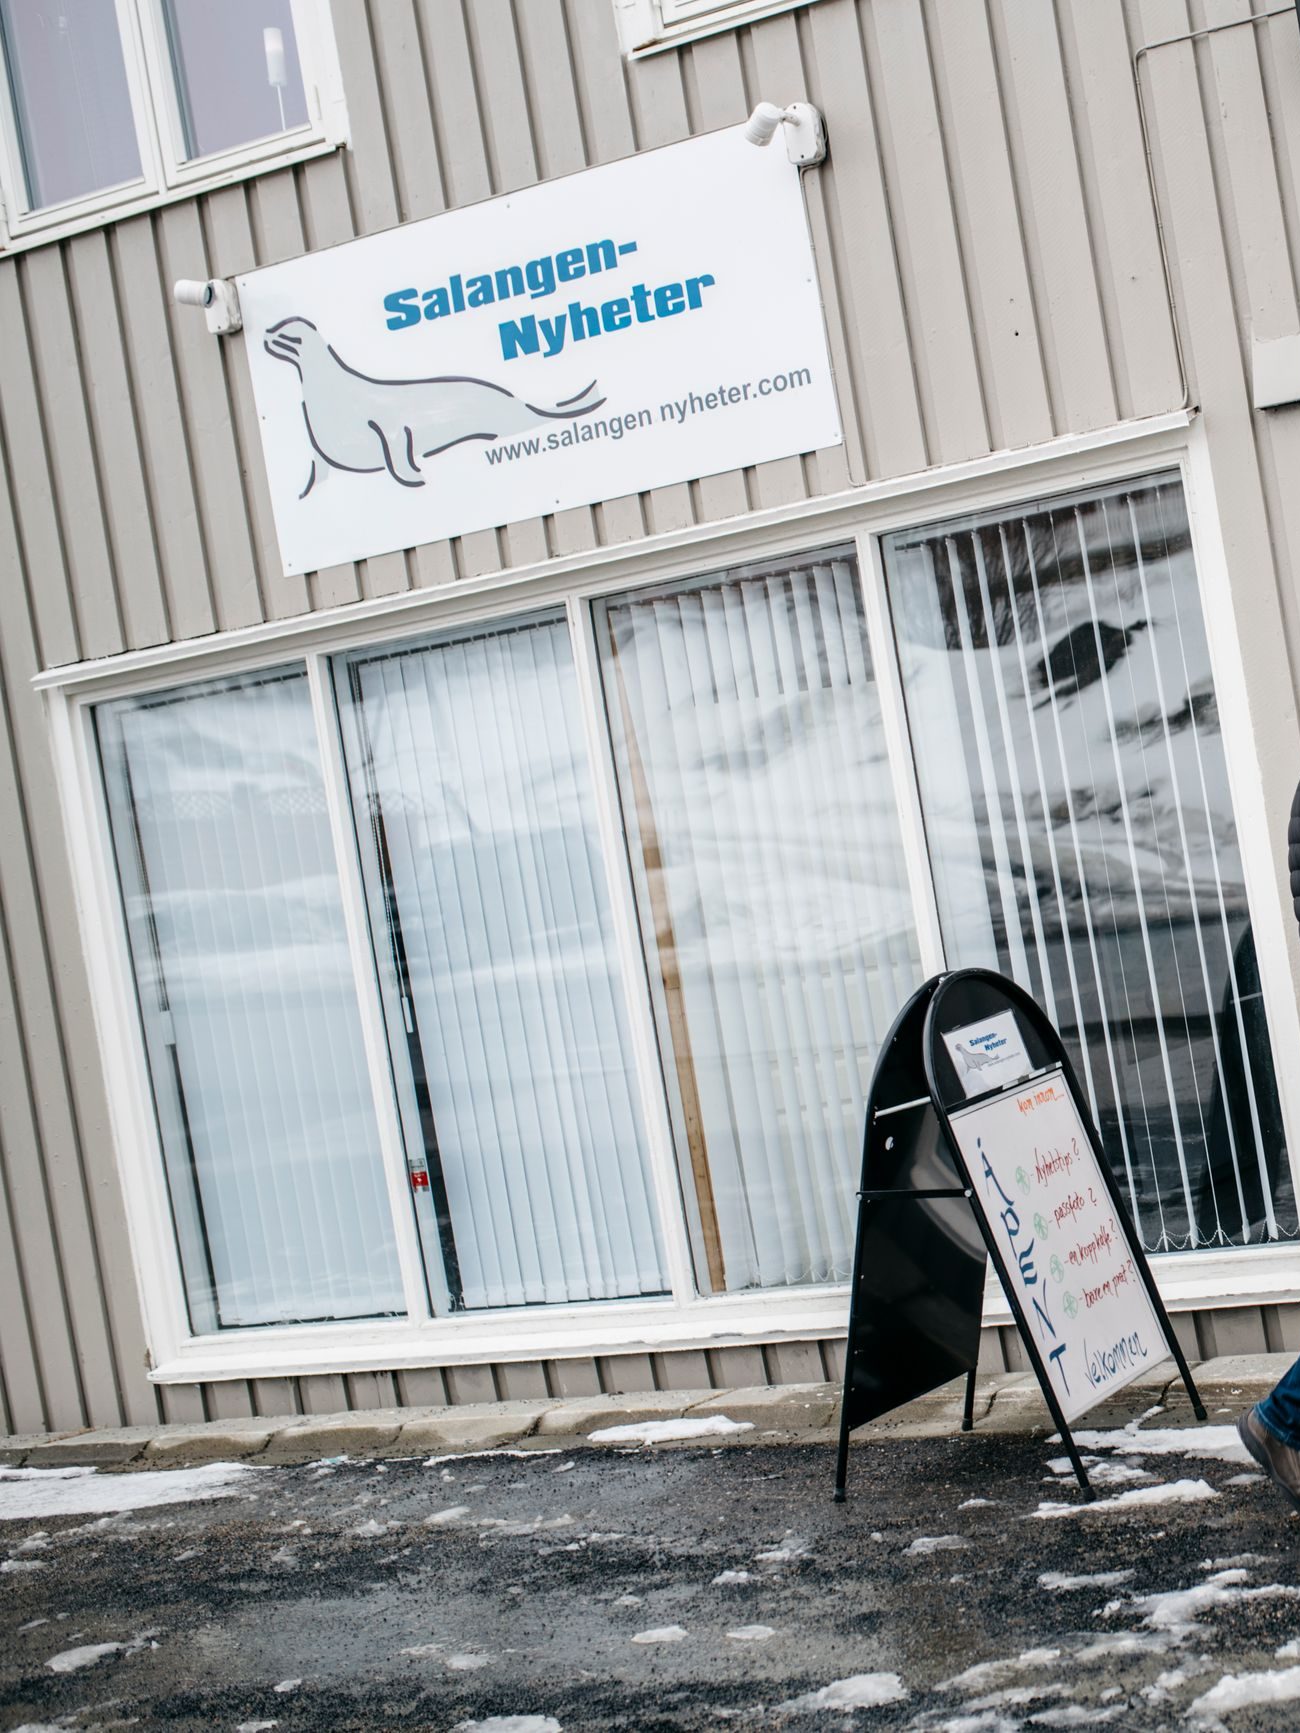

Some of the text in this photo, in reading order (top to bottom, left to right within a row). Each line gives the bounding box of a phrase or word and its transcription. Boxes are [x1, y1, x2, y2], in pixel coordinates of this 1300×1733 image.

[382, 237, 638, 332] Salangen-
[498, 273, 716, 361] Nyheter
[484, 367, 812, 467] www.salangen nyheter.com
